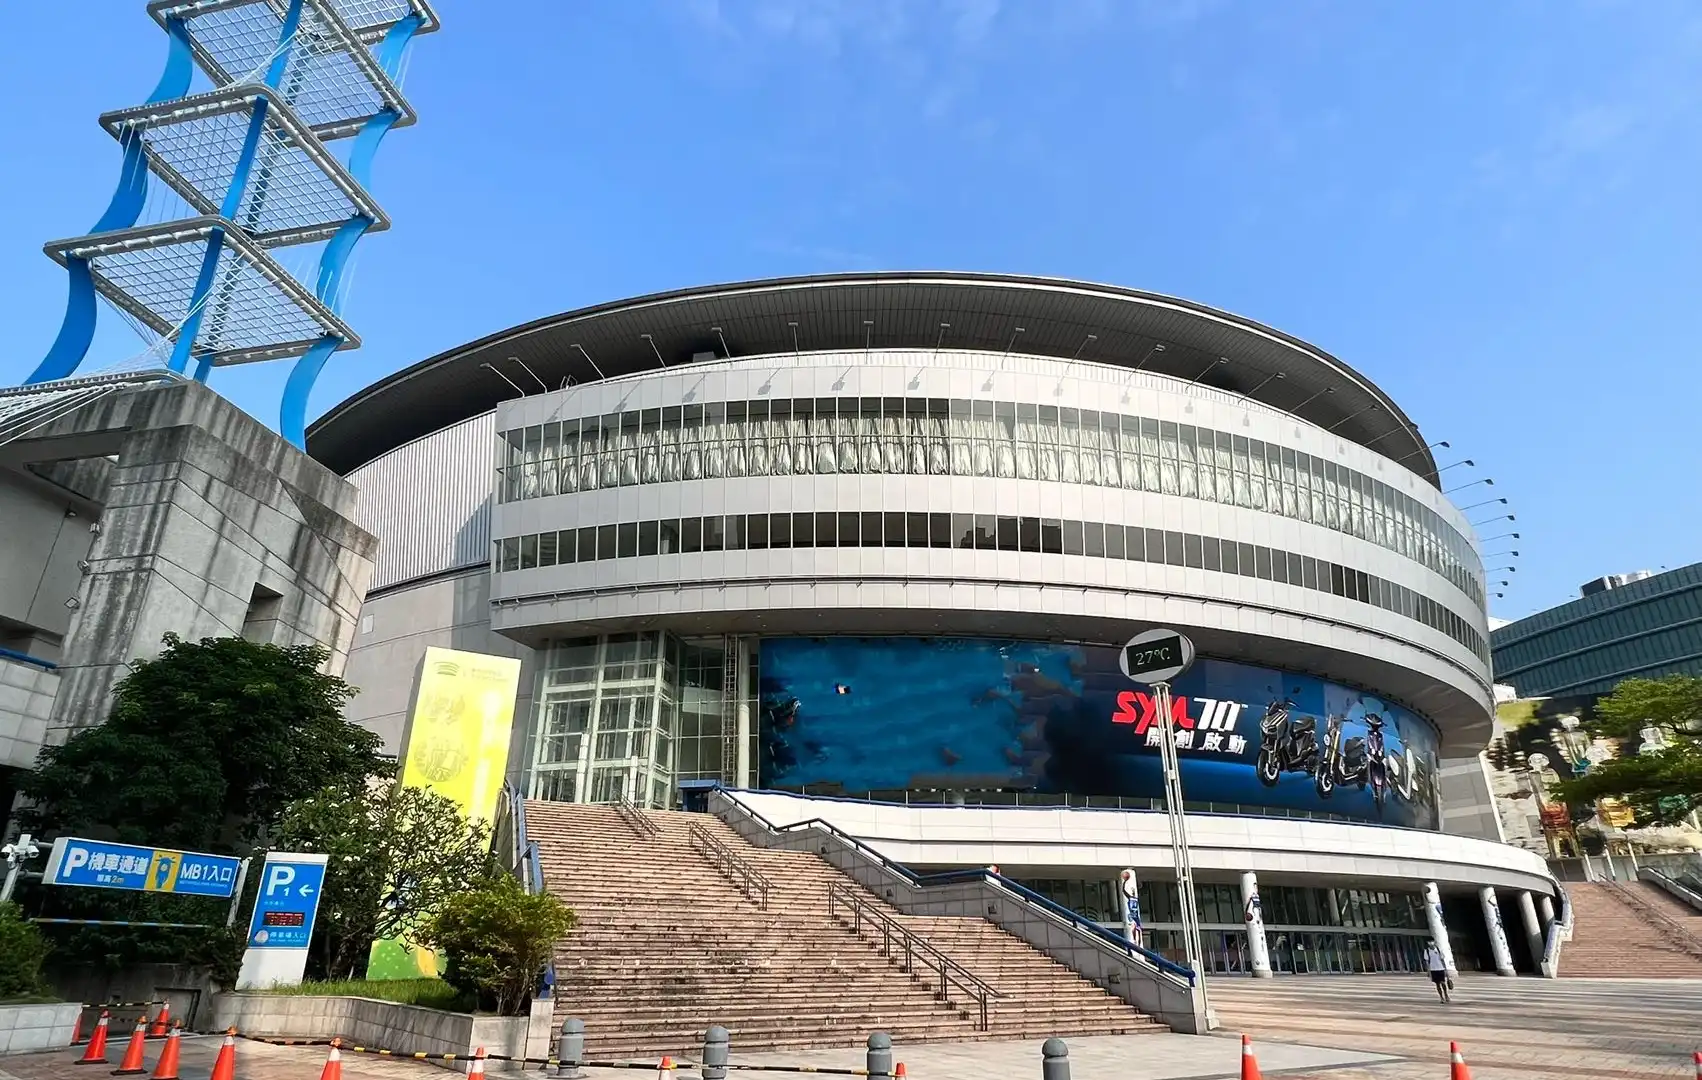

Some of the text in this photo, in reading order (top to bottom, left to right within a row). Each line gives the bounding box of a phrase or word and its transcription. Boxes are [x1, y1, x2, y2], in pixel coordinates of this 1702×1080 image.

[1135, 647, 1171, 666] 27°C
[1112, 691, 1195, 735] SYM
[62, 847, 150, 878] P 機車通道
[180, 862, 233, 882] MB1入口
